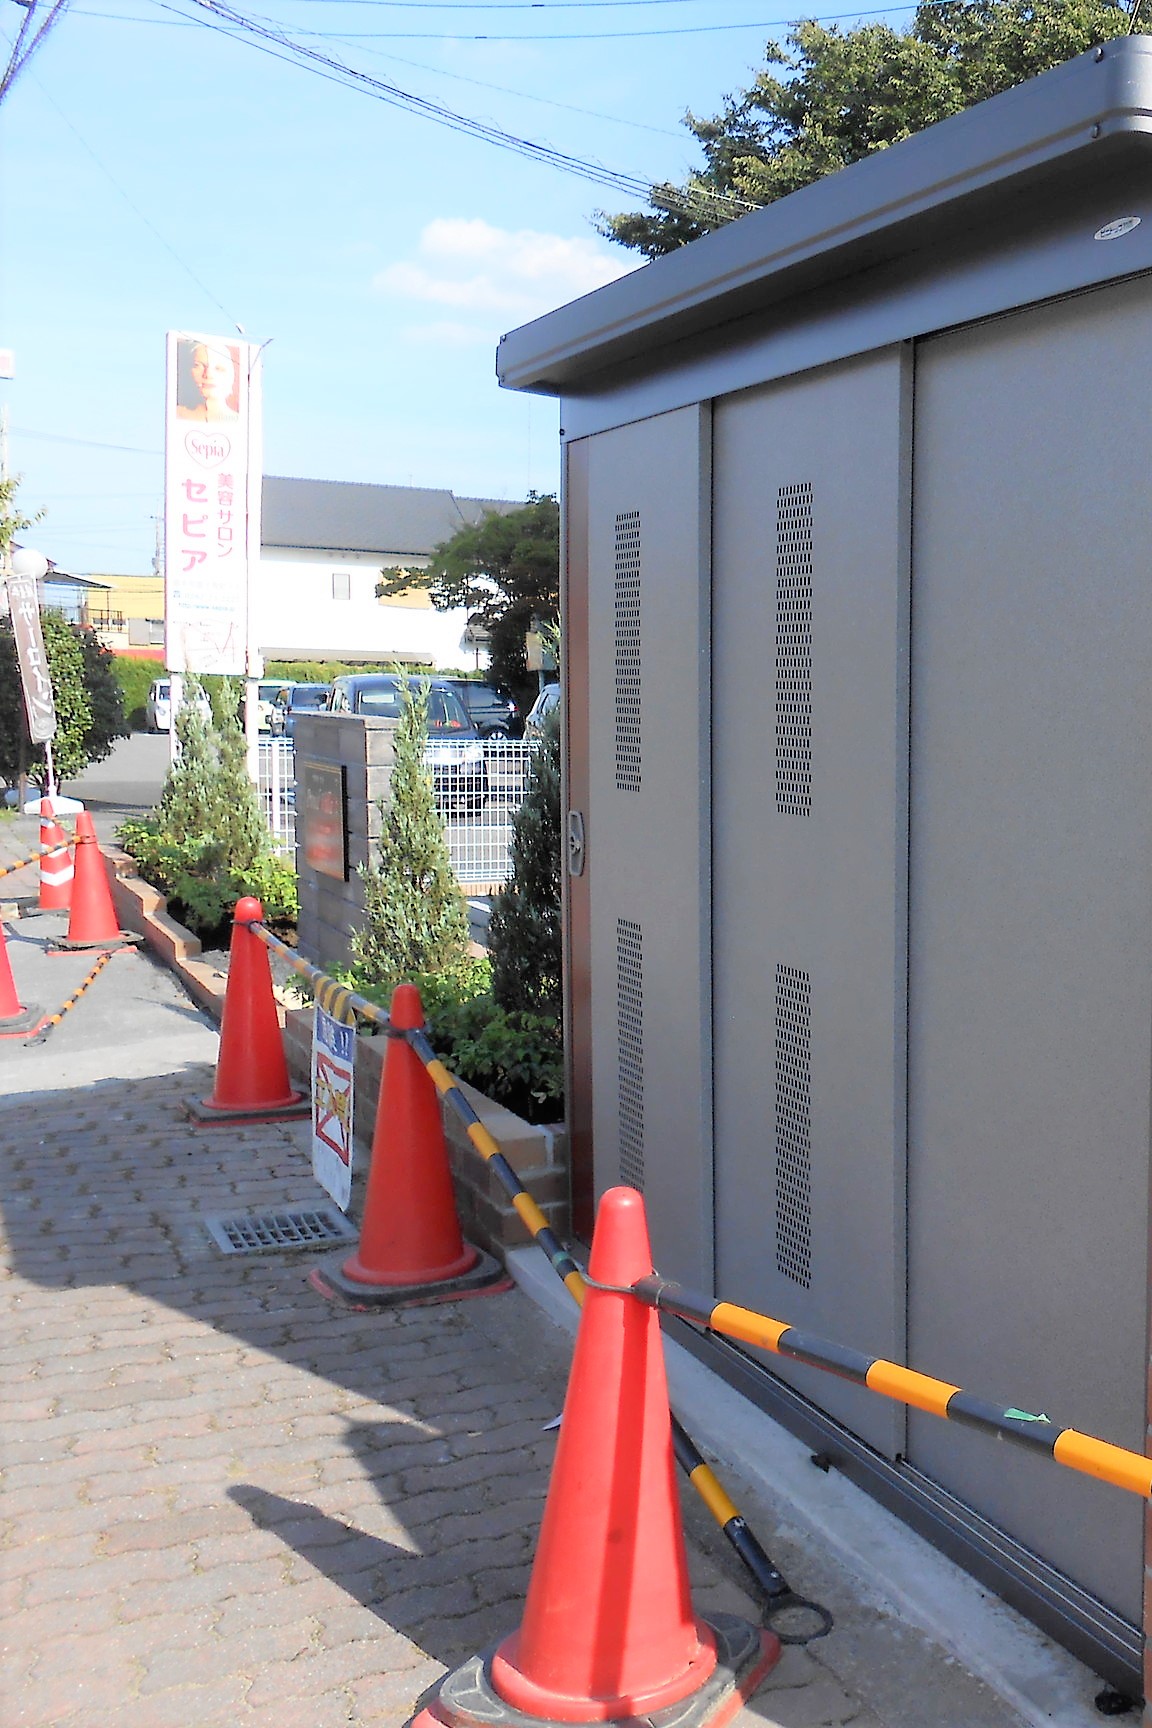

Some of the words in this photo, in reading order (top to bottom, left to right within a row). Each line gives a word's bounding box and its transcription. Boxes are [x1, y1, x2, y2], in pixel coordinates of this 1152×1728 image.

[191, 438, 224, 460] Sepia
[181, 478, 209, 571] セピア
[217, 472, 234, 558] 美容サロン
